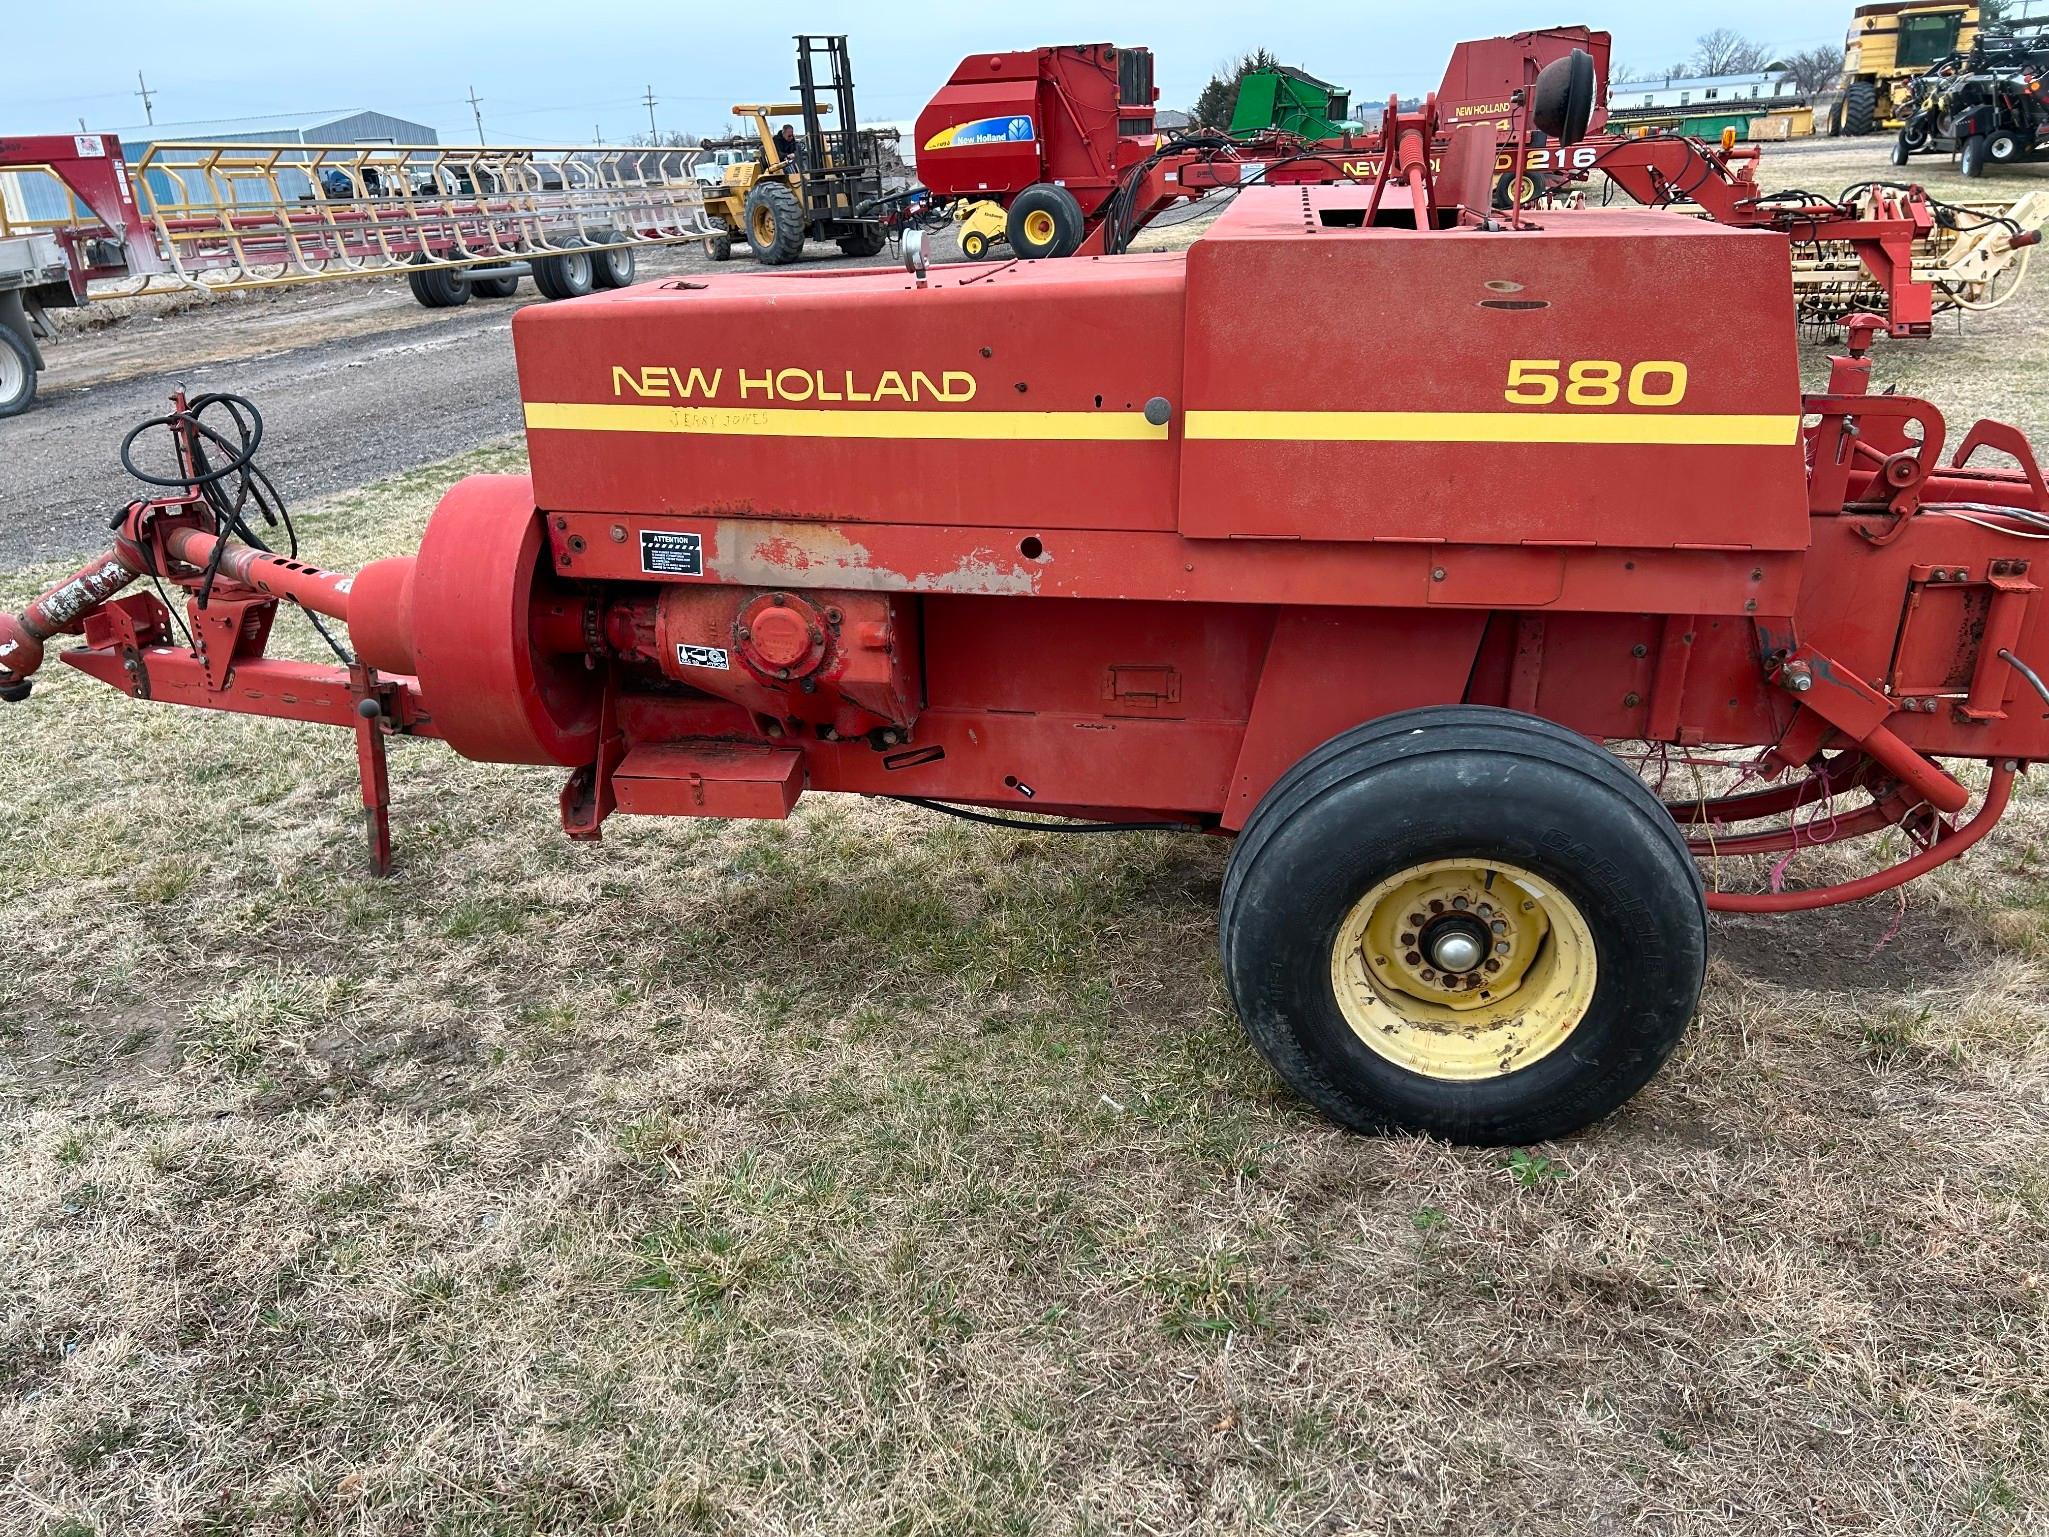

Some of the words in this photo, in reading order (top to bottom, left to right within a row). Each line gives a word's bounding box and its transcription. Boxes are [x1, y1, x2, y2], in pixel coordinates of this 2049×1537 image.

[1456, 106, 1473, 117] NEW
[1474, 102, 1510, 115] HOLLAND
[957, 136, 975, 145] New
[976, 132, 1006, 143] Holland
[1526, 147, 1597, 170] 216
[612, 365, 723, 399] NEW
[738, 367, 978, 402] HOLLAND
[1504, 359, 1688, 407] 580
[653, 535, 689, 545] ATTENTION
